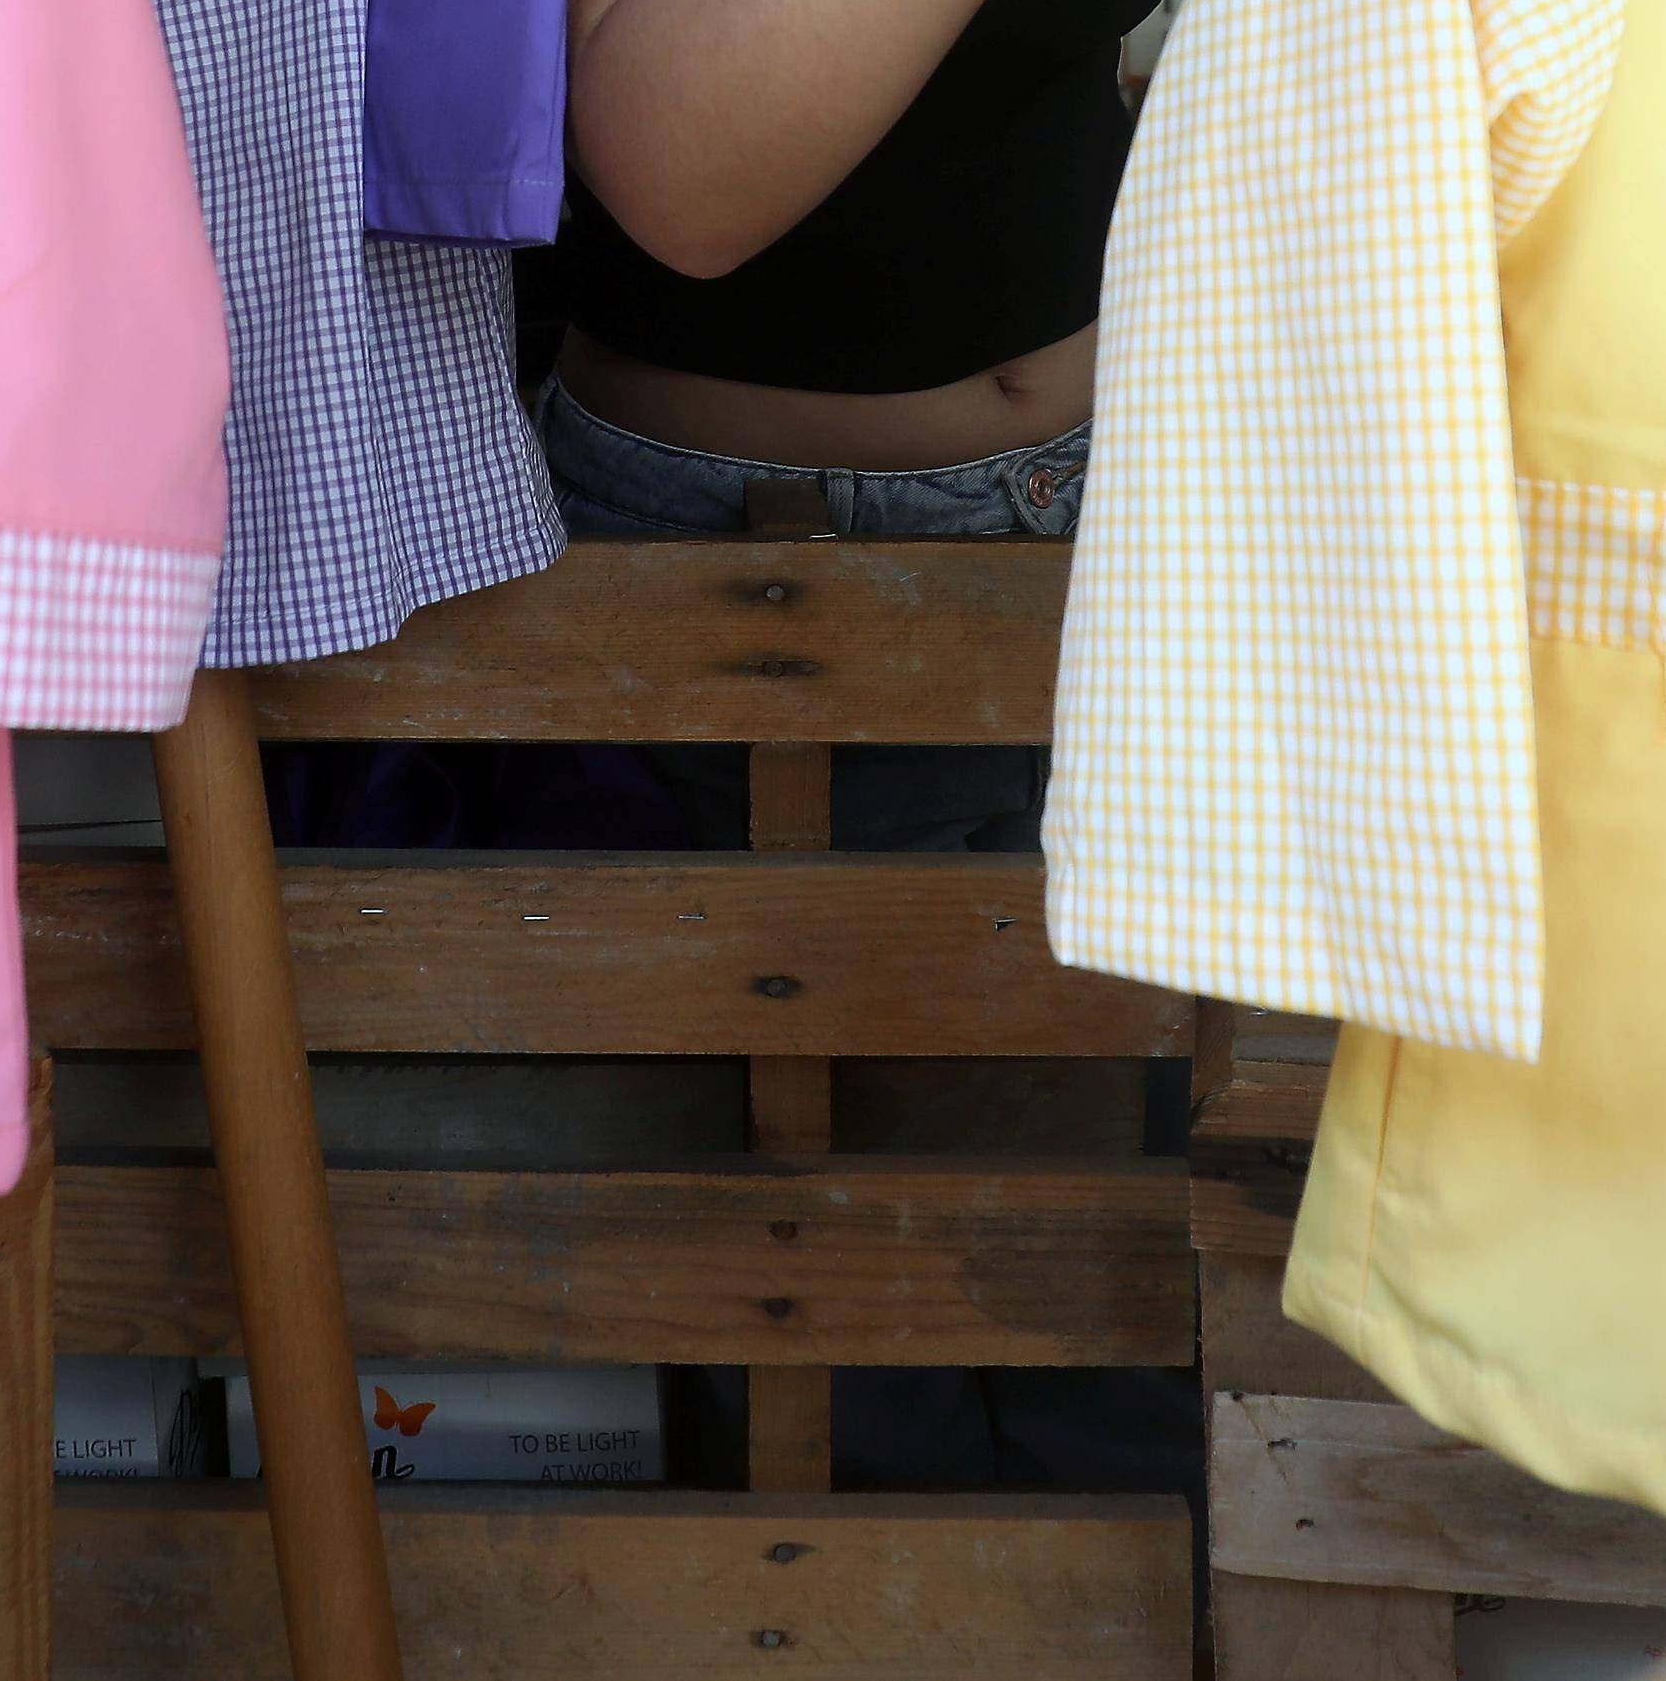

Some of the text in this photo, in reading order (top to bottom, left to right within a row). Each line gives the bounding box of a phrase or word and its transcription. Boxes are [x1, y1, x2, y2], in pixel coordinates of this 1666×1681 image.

[73, 1439, 137, 1459] LIGHT
[509, 1430, 641, 1454] TO BE LIGHT
[540, 1461, 643, 1481] AT WORK!
